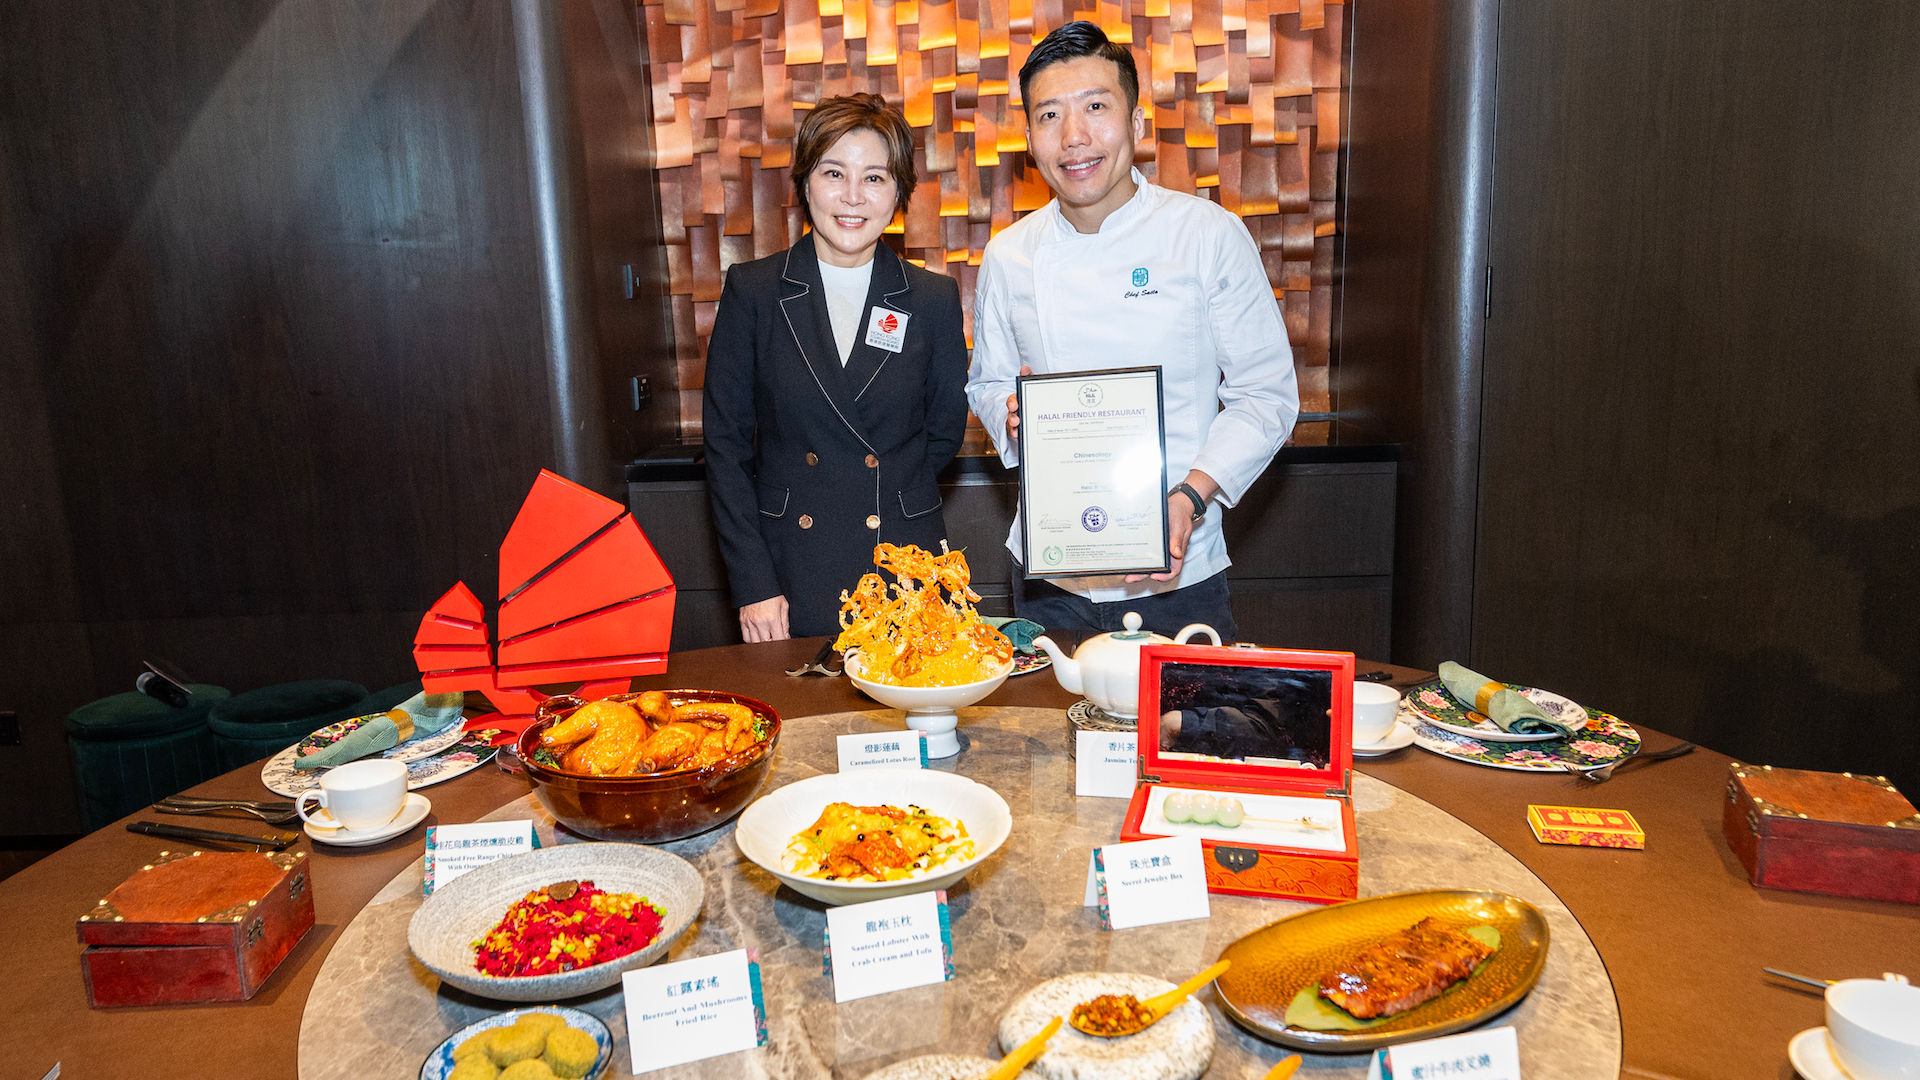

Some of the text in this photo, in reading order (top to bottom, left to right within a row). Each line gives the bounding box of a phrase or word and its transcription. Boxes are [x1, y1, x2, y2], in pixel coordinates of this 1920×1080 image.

[1037, 408, 1146, 421] HALAL FRIENDLY RESTAURANT
[1108, 742, 1135, 751] 香片茶
[477, 854, 496, 862] Range
[1129, 855, 1172, 869] 珠光寶盒
[1121, 879, 1142, 887] Secret
[1144, 876, 1168, 884] Jewelry
[882, 937, 909, 947] Lobster
[912, 933, 930, 942] With
[851, 947, 932, 968] Crab Cream and Tofu
[642, 995, 748, 1022] Beetroot And Mushrooms
[675, 1013, 718, 1027] Fried Rice
